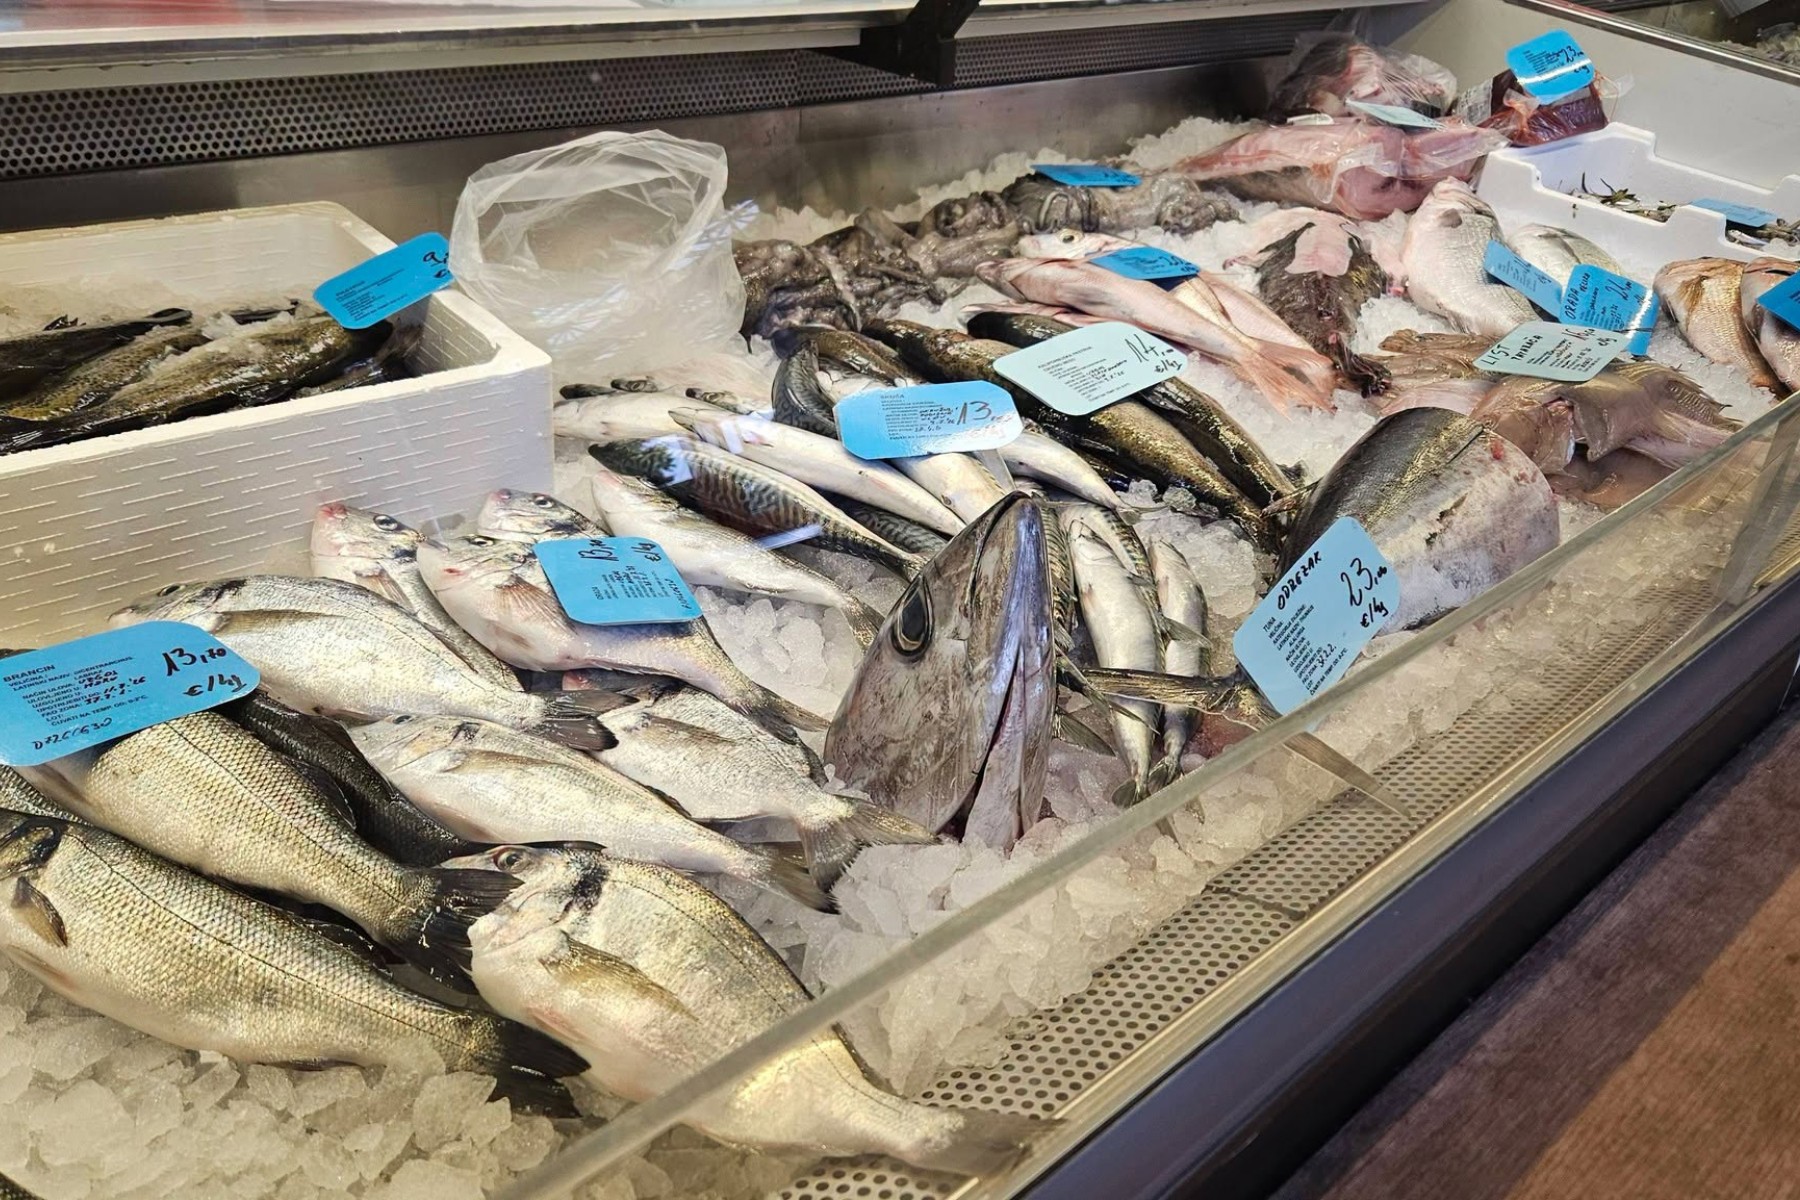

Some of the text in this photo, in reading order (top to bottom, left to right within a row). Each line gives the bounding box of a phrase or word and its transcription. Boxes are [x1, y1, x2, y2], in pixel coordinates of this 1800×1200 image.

[1480, 344, 1511, 366] LIST
[1277, 551, 1322, 610] ODREZAK
[1360, 597, 1390, 628] €/kg
[1263, 616, 1277, 633] TUNA
[3, 664, 56, 682] BRANCIN
